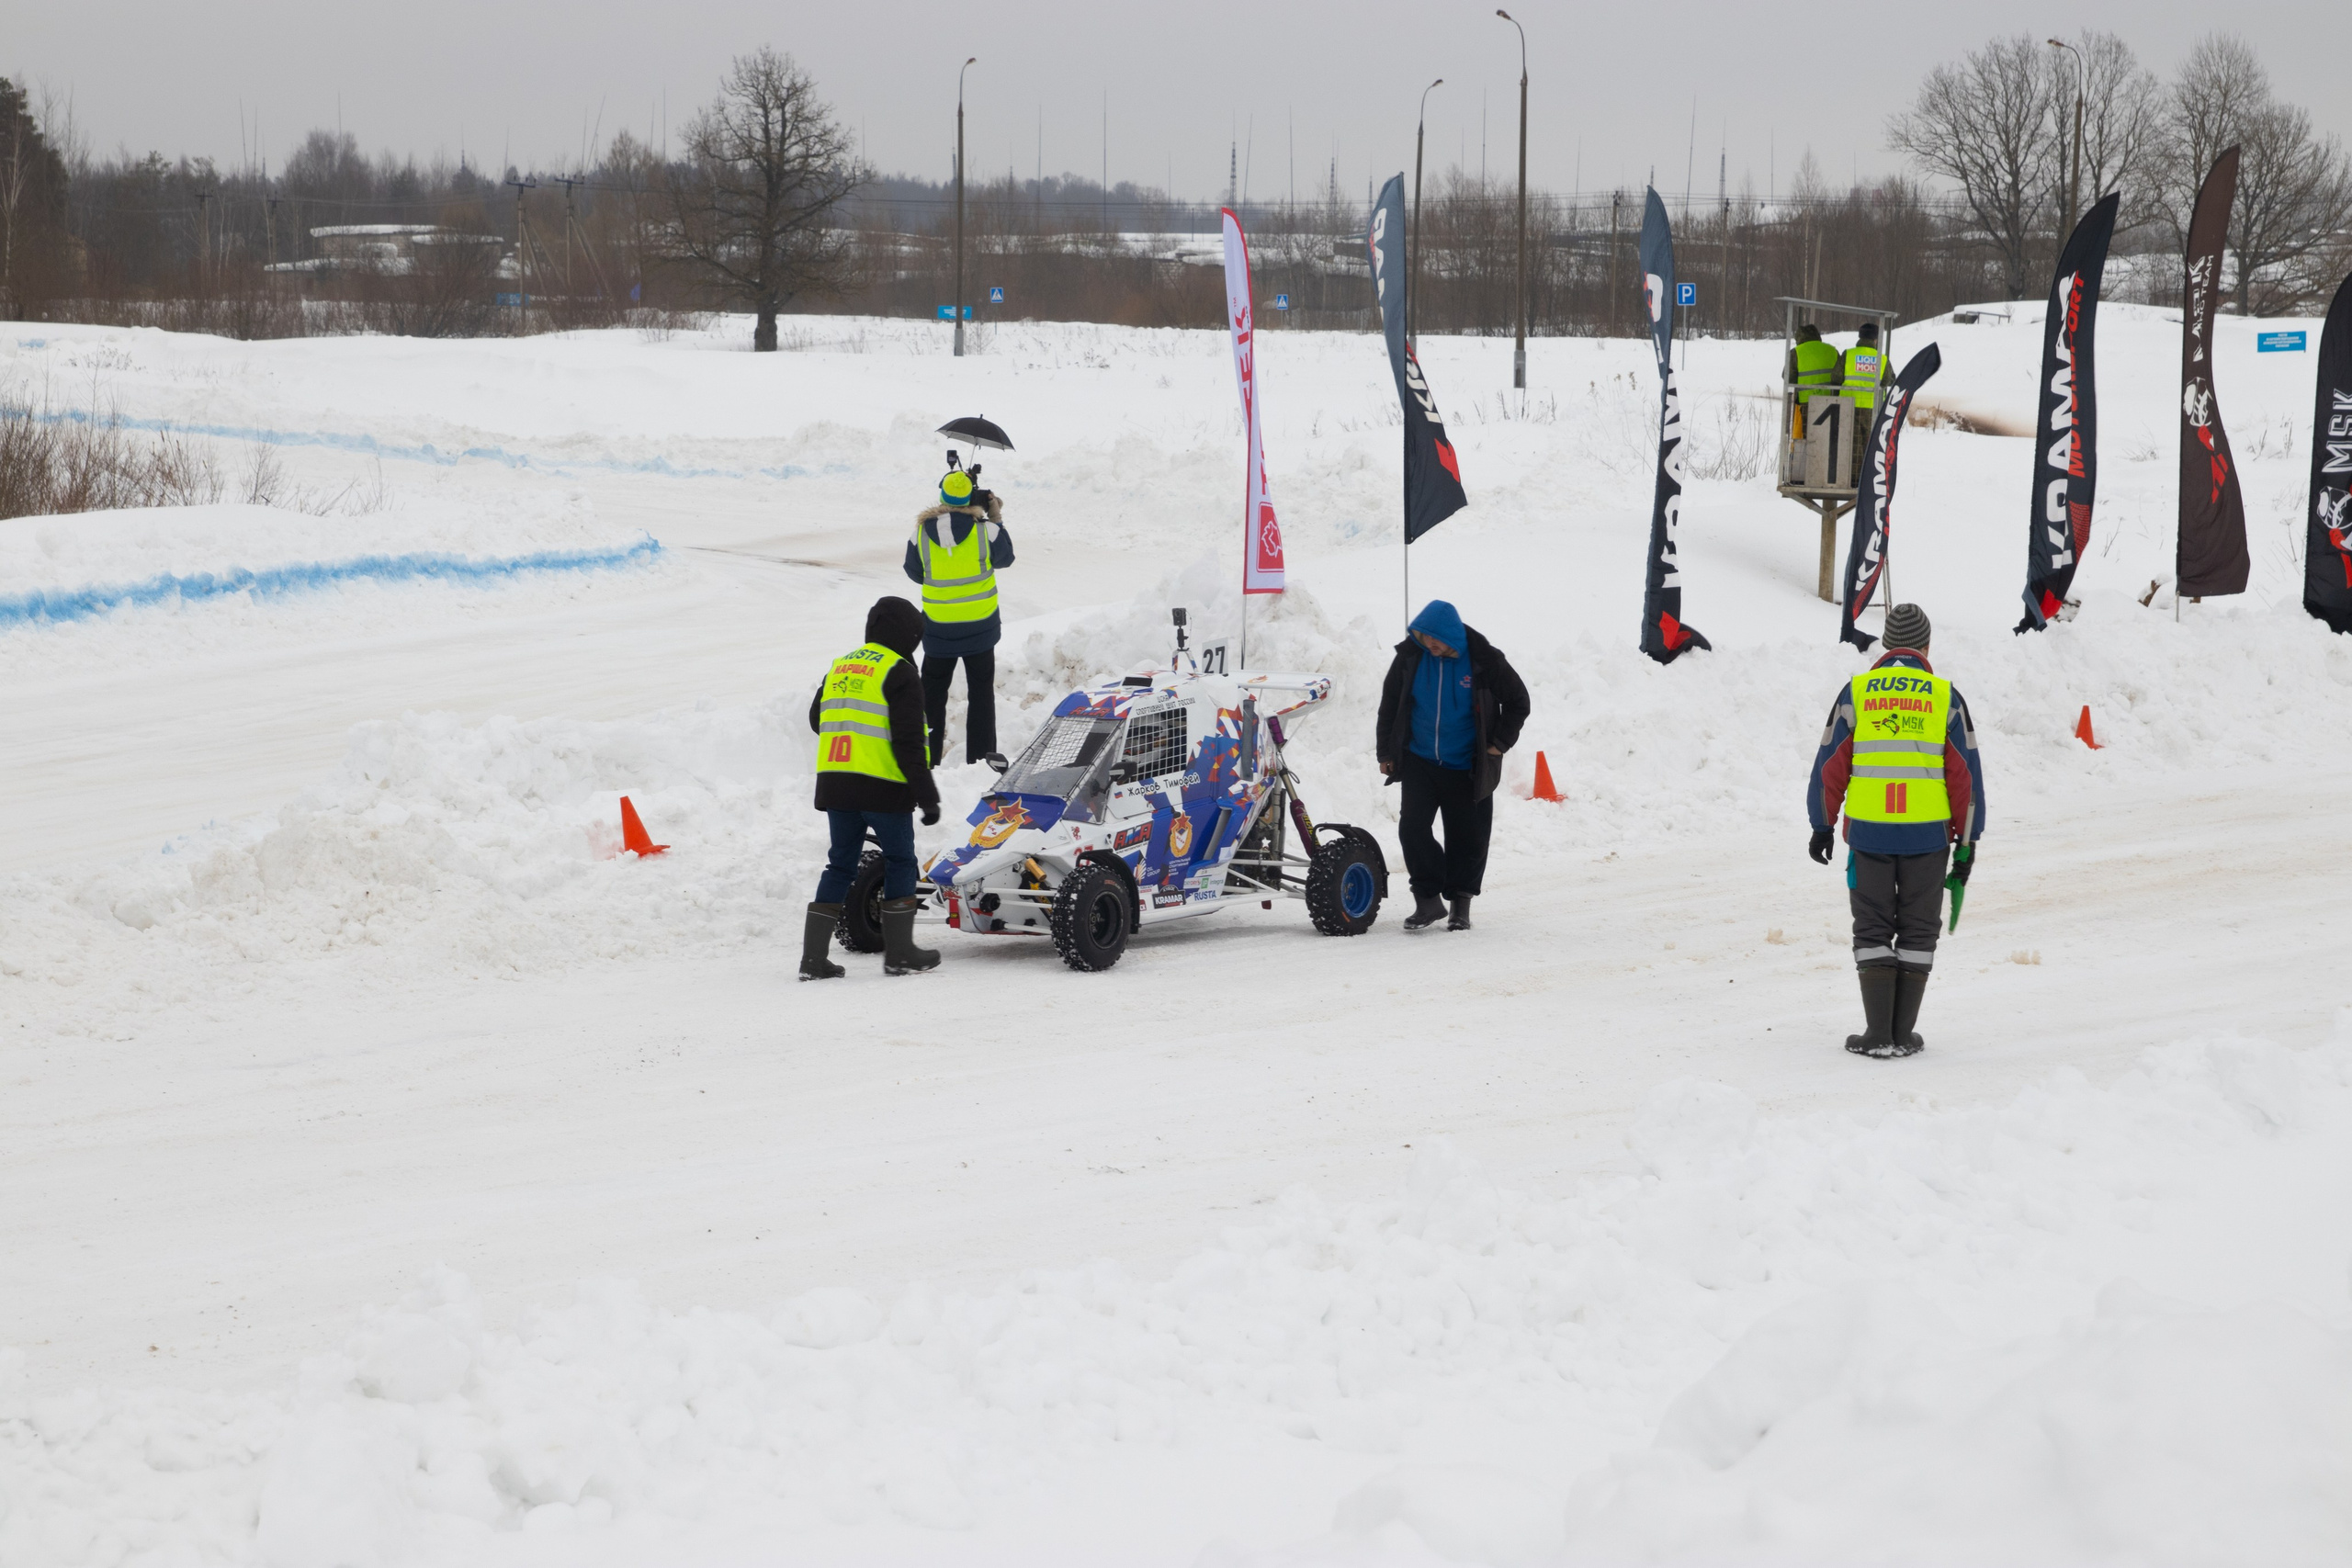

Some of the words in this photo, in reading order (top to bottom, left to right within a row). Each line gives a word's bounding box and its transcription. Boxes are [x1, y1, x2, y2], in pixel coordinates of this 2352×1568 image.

[2200, 254, 2214, 297] TEAM
[1681, 286, 1692, 303] P
[1857, 355, 1876, 364] LIQU
[2322, 389, 2352, 472] MSK
[1813, 403, 1840, 484] 1
[1855, 385, 1906, 591] KRAMAR
[1203, 646, 1226, 673] 27
[1866, 677, 1933, 694] RUSTA
[1864, 697, 1933, 713] МАРШАЛ
[1902, 716, 1925, 730] MSK
[827, 735, 852, 762] 10
[1126, 782, 1160, 797] Жарков
[1163, 773, 1200, 790] Тимофей
[1885, 783, 1906, 813] 11
[1155, 894, 1183, 905] KRAMAR
[1194, 890, 1216, 901] RUSTA
